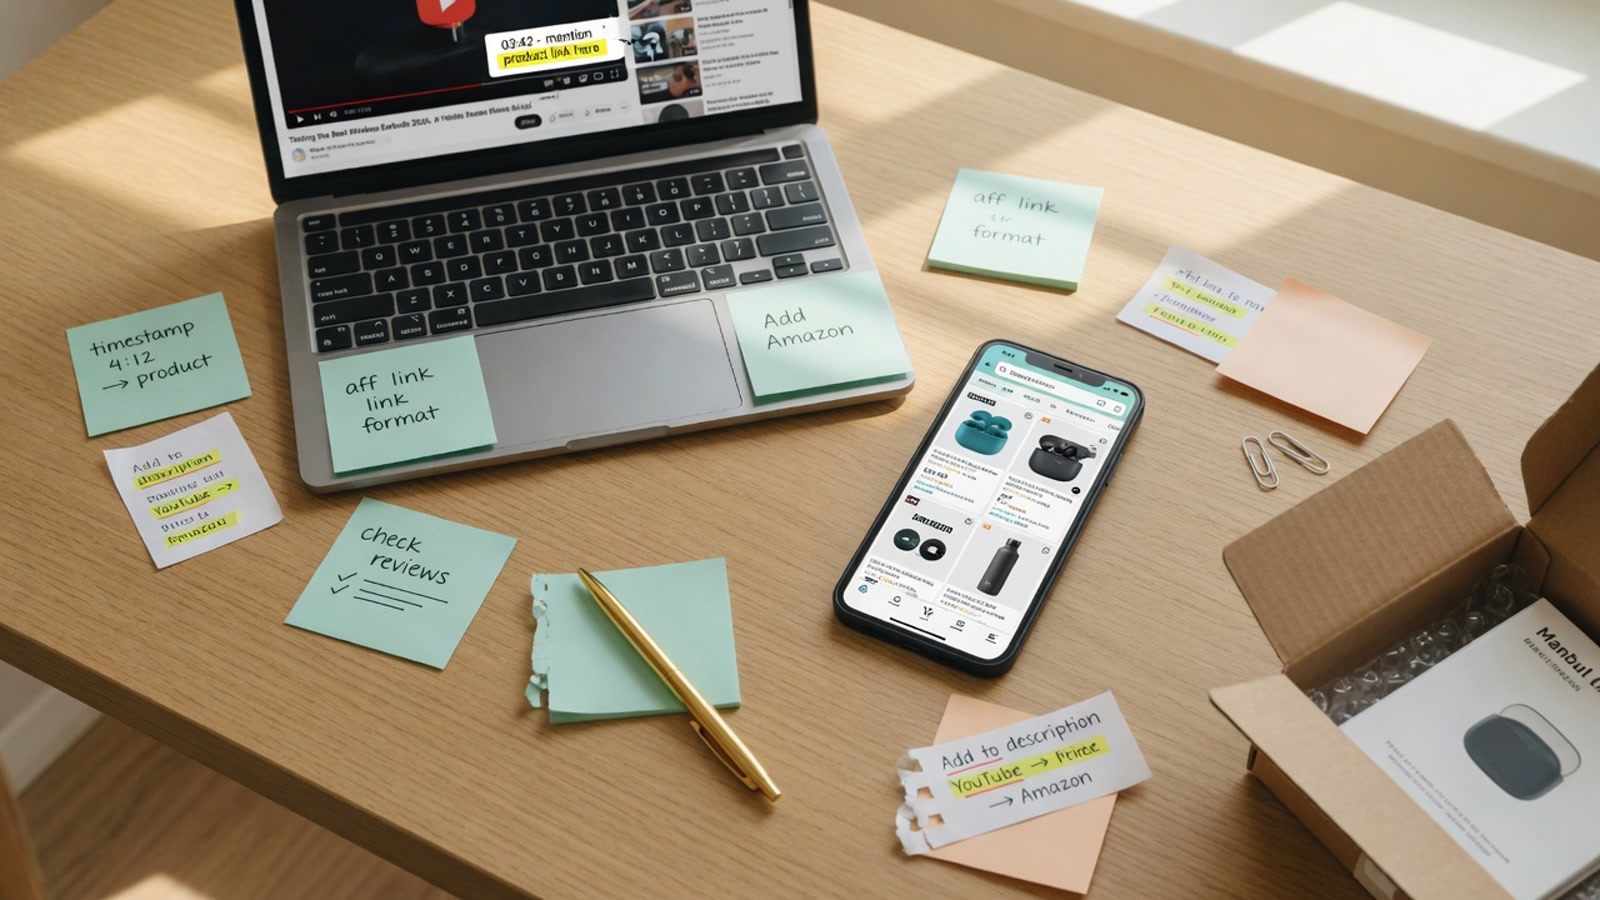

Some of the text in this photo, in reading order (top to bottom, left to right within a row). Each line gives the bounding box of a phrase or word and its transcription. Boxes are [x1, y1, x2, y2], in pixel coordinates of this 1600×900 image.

[973, 191, 1059, 213] aff link
[972, 223, 1046, 246] format
[764, 307, 807, 329] Add
[90, 321, 195, 356] timestamp
[767, 324, 854, 350] Amazon
[109, 350, 155, 371] 4:12
[136, 354, 212, 389] product
[345, 367, 434, 395] aff link
[366, 394, 409, 412] link
[362, 405, 440, 434] format
[360, 527, 422, 554] check
[370, 554, 450, 585] reviews
[941, 711, 1101, 771] Add to description
[951, 764, 1023, 794] YouTube
[1020, 770, 1093, 804] Amazon
